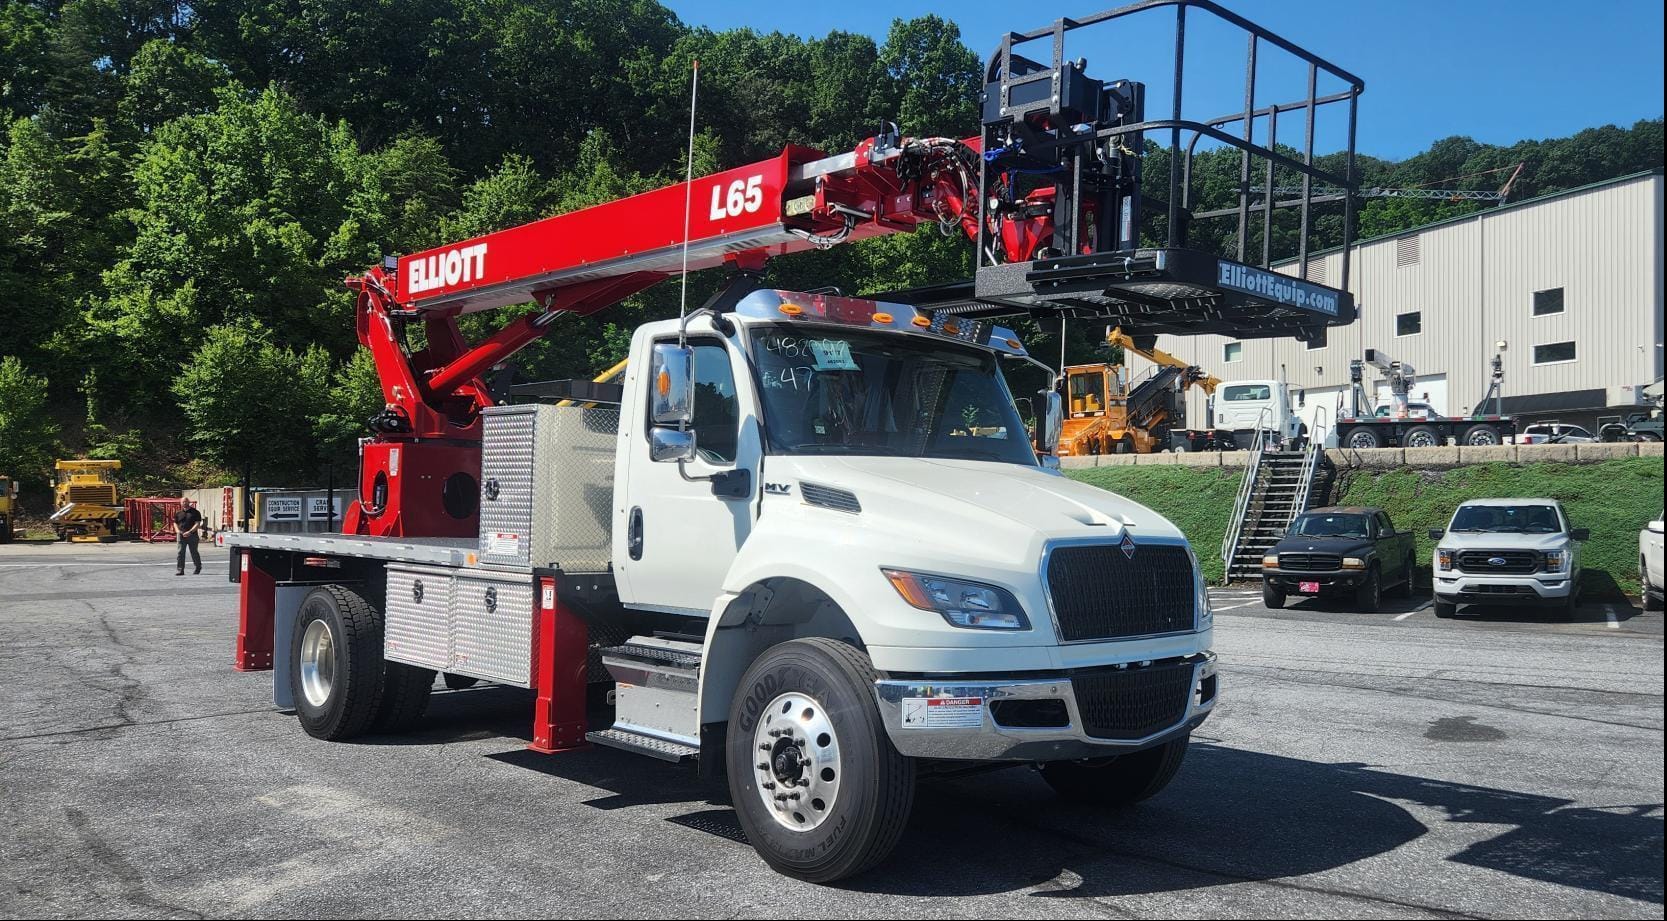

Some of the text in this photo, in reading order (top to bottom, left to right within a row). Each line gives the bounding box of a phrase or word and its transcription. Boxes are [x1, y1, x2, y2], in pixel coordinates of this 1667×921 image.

[710, 175, 763, 221] L65
[408, 242, 488, 294] ELLIOTT
[1221, 262, 1336, 313] ElliottEquip.com
[780, 366, 813, 392] 47
[765, 483, 791, 492] MV
[818, 815, 847, 852] FUEL
